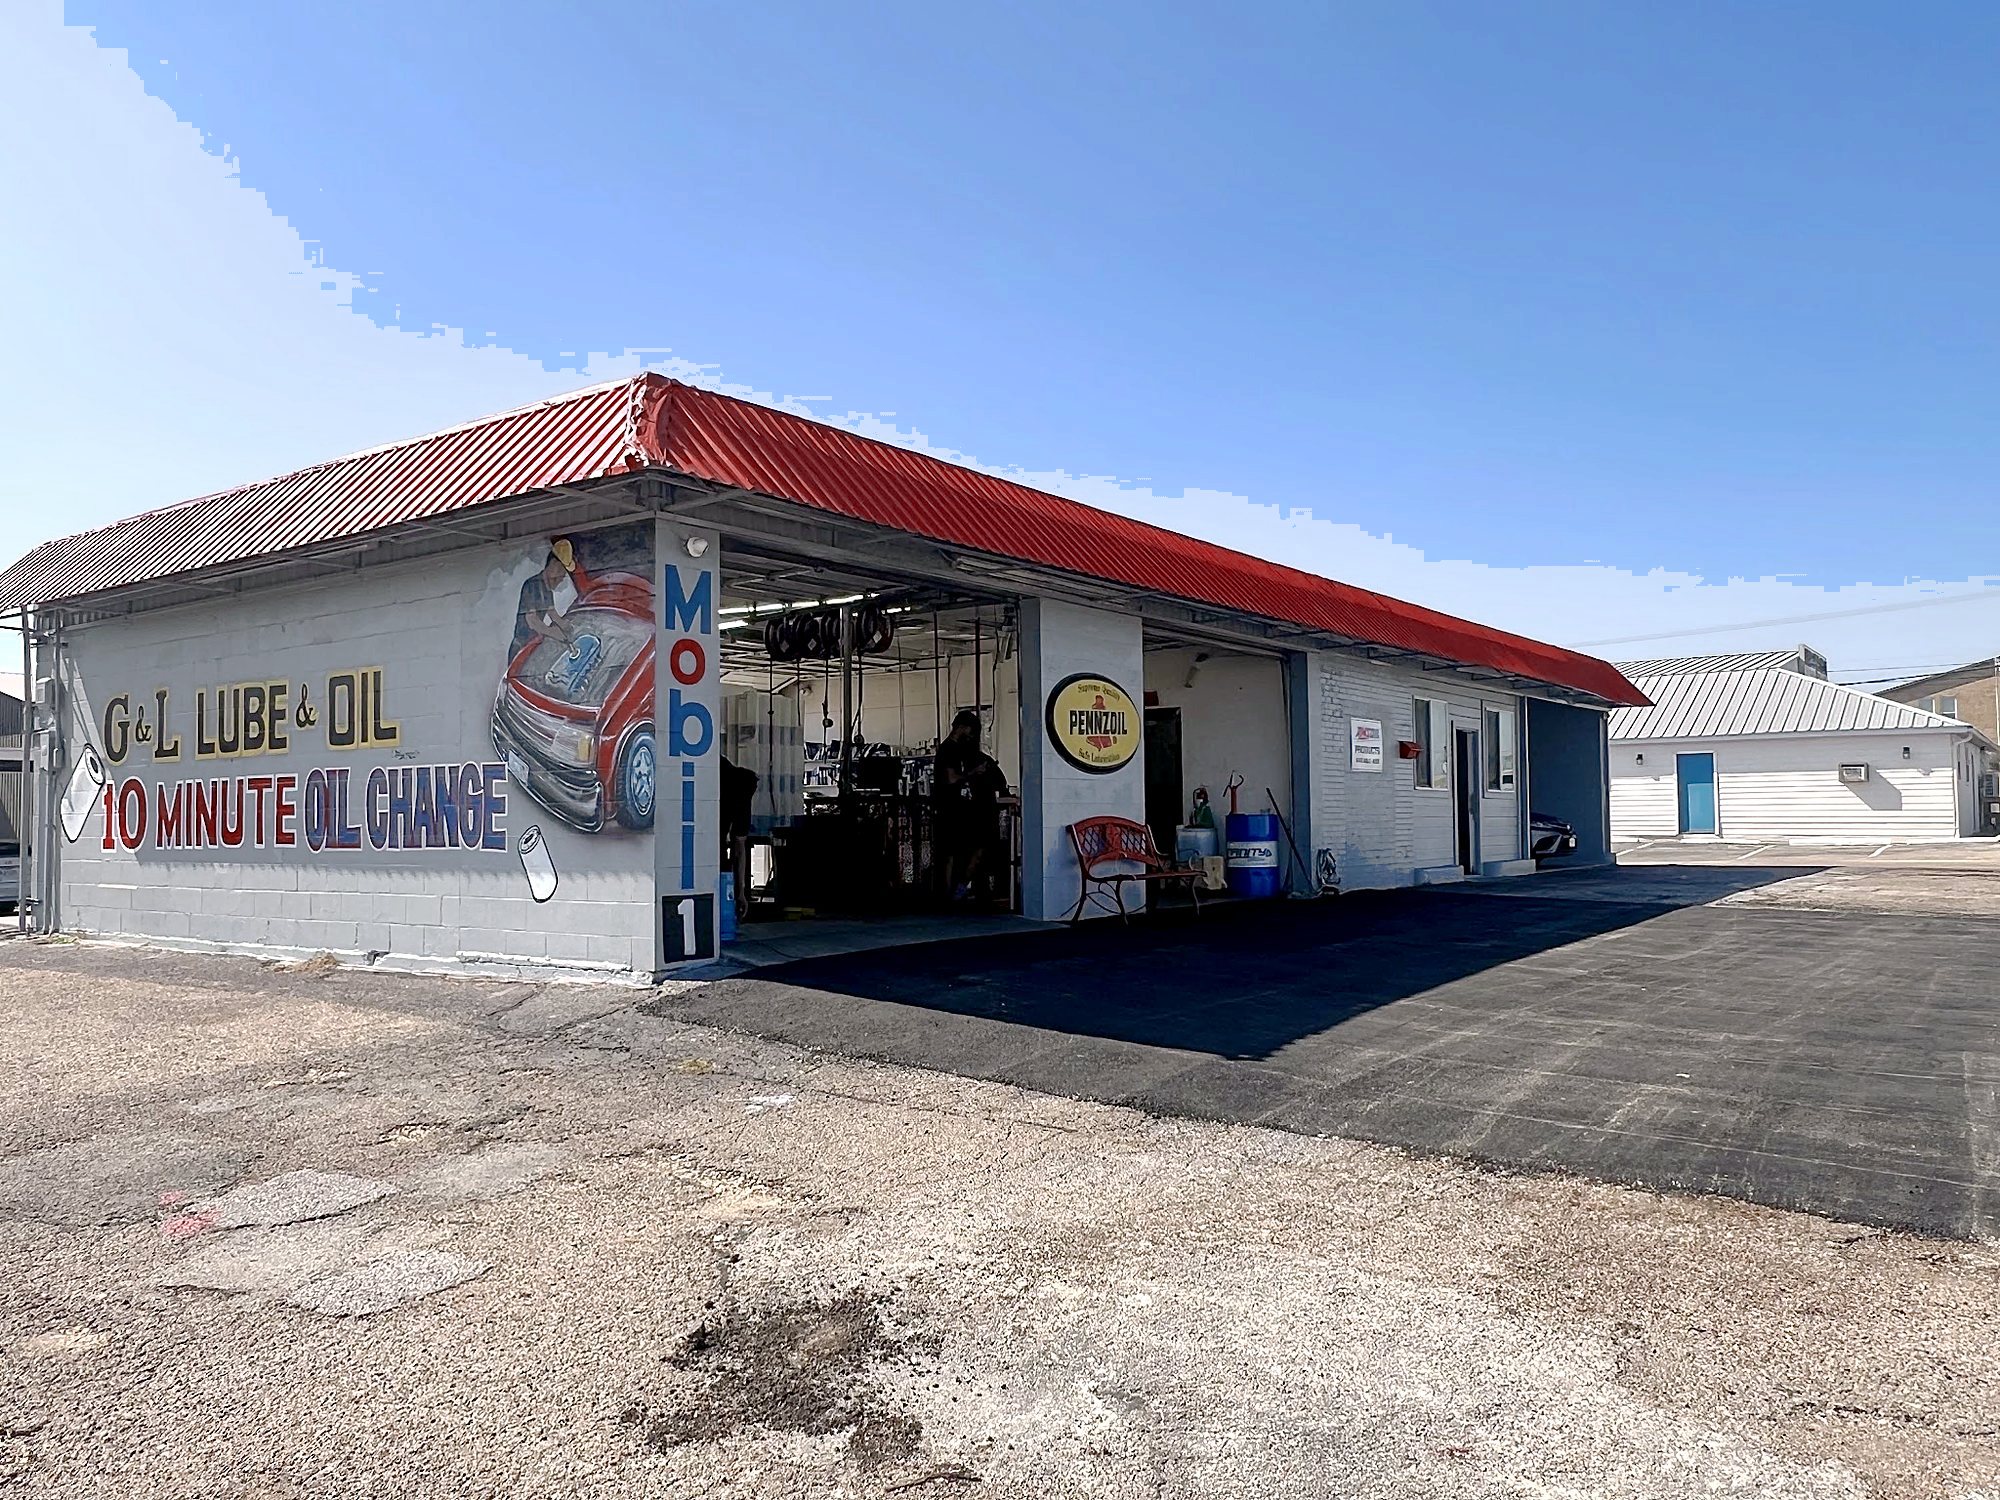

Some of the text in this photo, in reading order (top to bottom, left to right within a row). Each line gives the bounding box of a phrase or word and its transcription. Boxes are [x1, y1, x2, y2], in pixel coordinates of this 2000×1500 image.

[195, 679, 290, 761] LUBE
[295, 683, 319, 731] &
[326, 666, 403, 751] OIL
[665, 564, 713, 956] Mobil 1
[1069, 710, 1128, 735] PENNZOIL
[101, 761, 508, 854] 10 MINUTE OIL CHANGE
